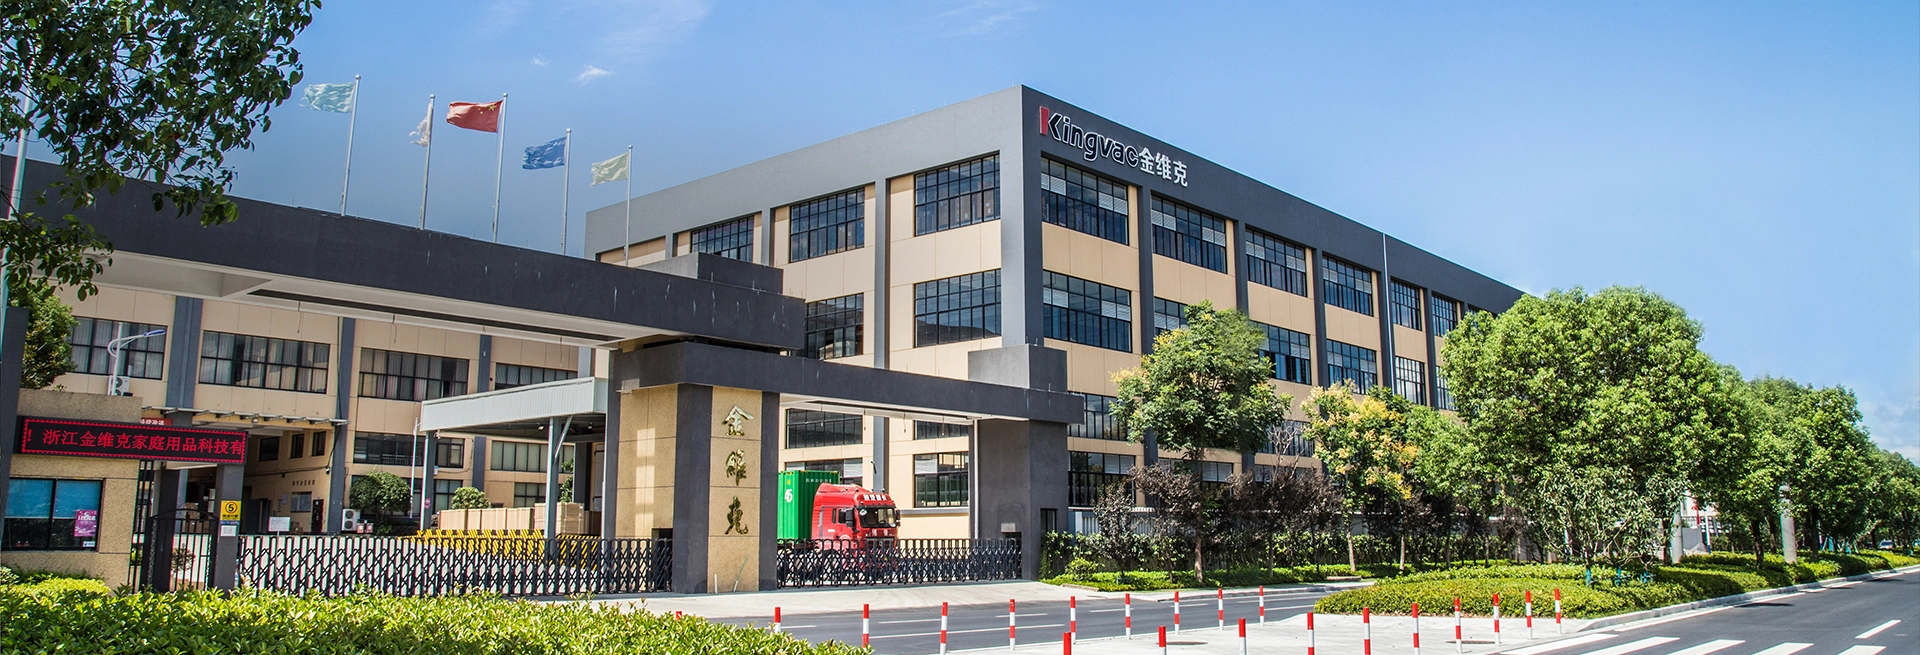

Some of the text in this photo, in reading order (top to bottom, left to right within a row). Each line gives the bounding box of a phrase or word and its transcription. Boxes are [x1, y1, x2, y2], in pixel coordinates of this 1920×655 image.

[1040, 106, 1189, 187] Kingvac 金维克
